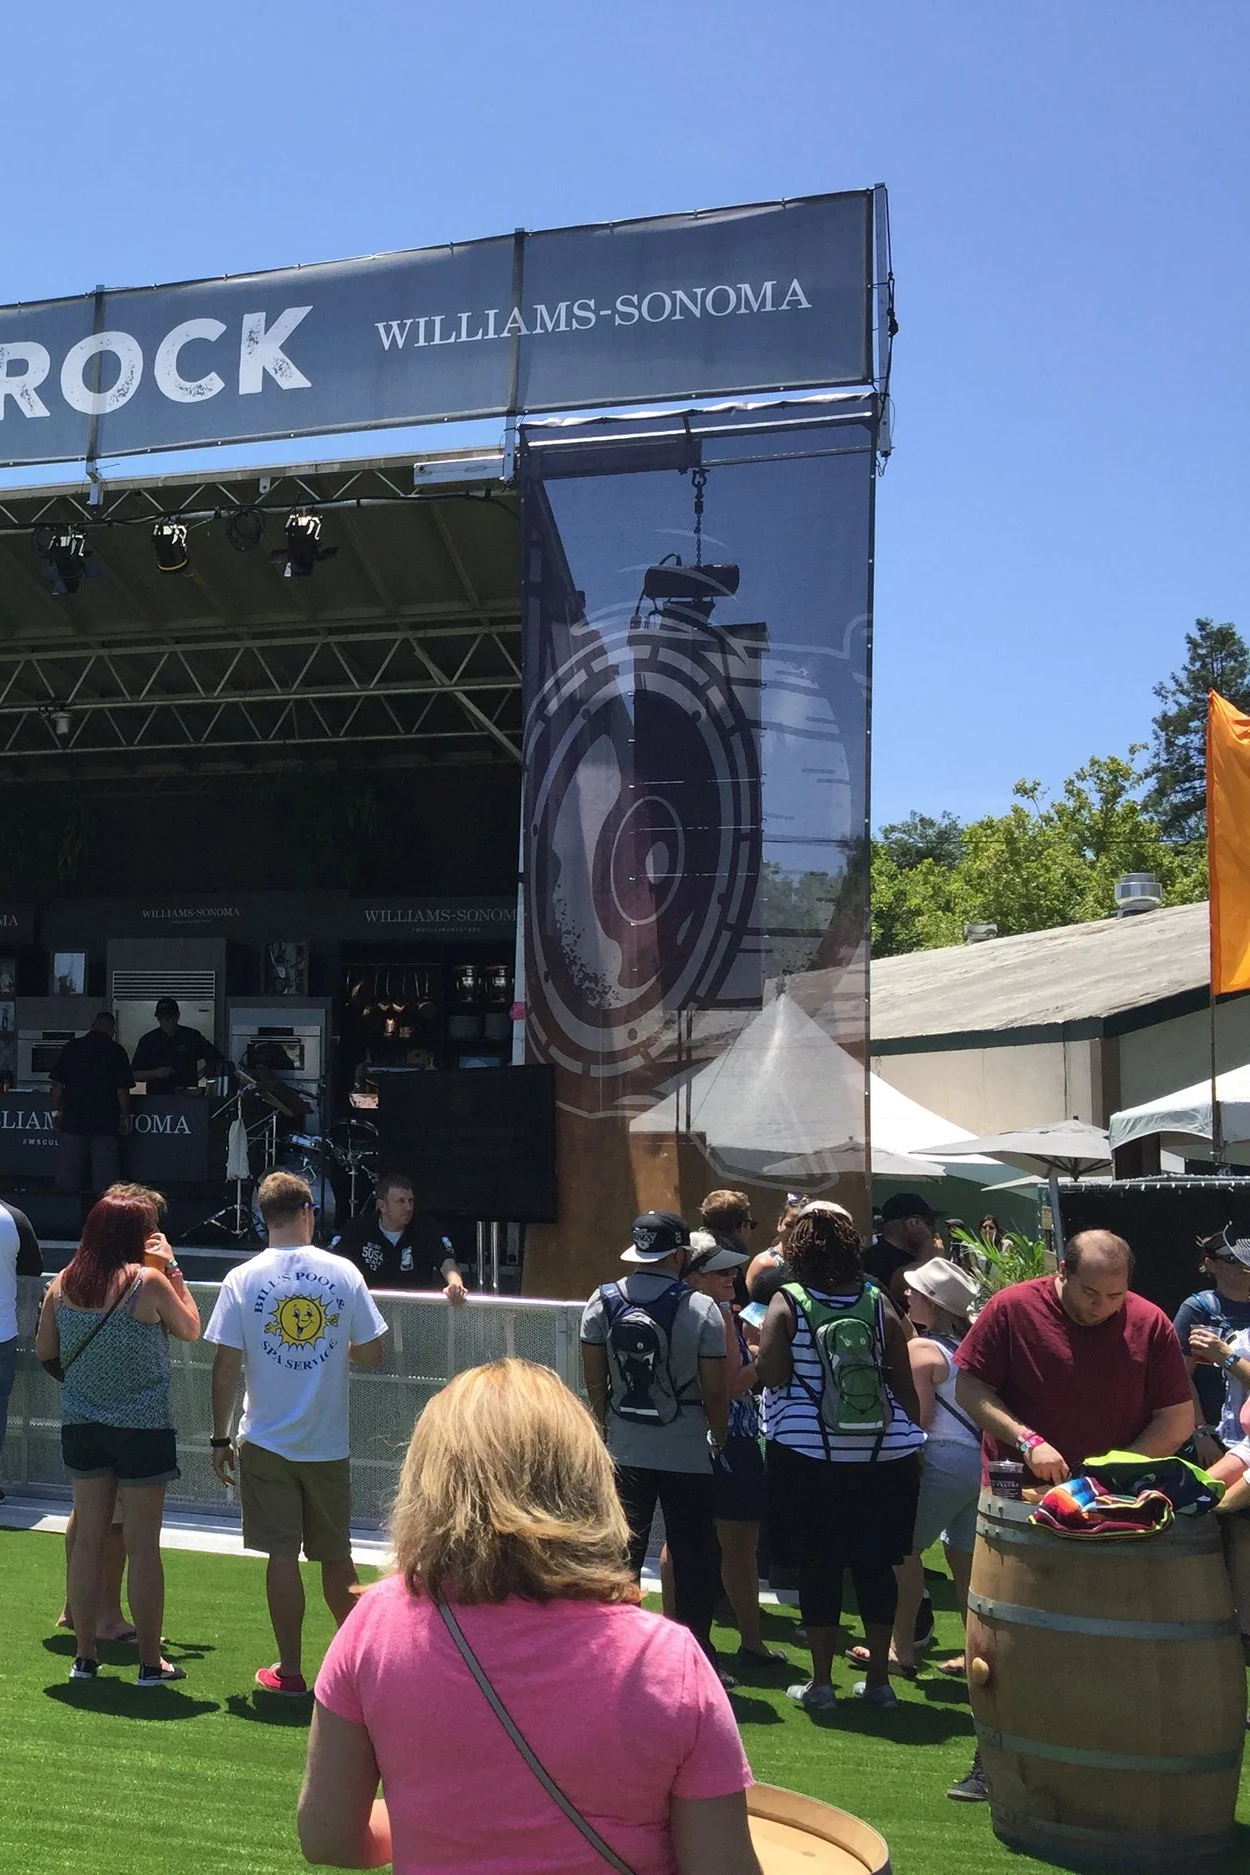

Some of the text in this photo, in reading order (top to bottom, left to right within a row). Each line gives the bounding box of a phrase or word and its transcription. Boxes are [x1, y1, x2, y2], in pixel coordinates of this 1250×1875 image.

[374, 278, 813, 352] WILLIAMS-SONOMA
[142, 907, 240, 919] WILLIAMS-SONOMA
[254, 1273, 290, 1313] BILL'S
[295, 1272, 336, 1295] POOL
[261, 1338, 338, 1370] SPA SERVICE
